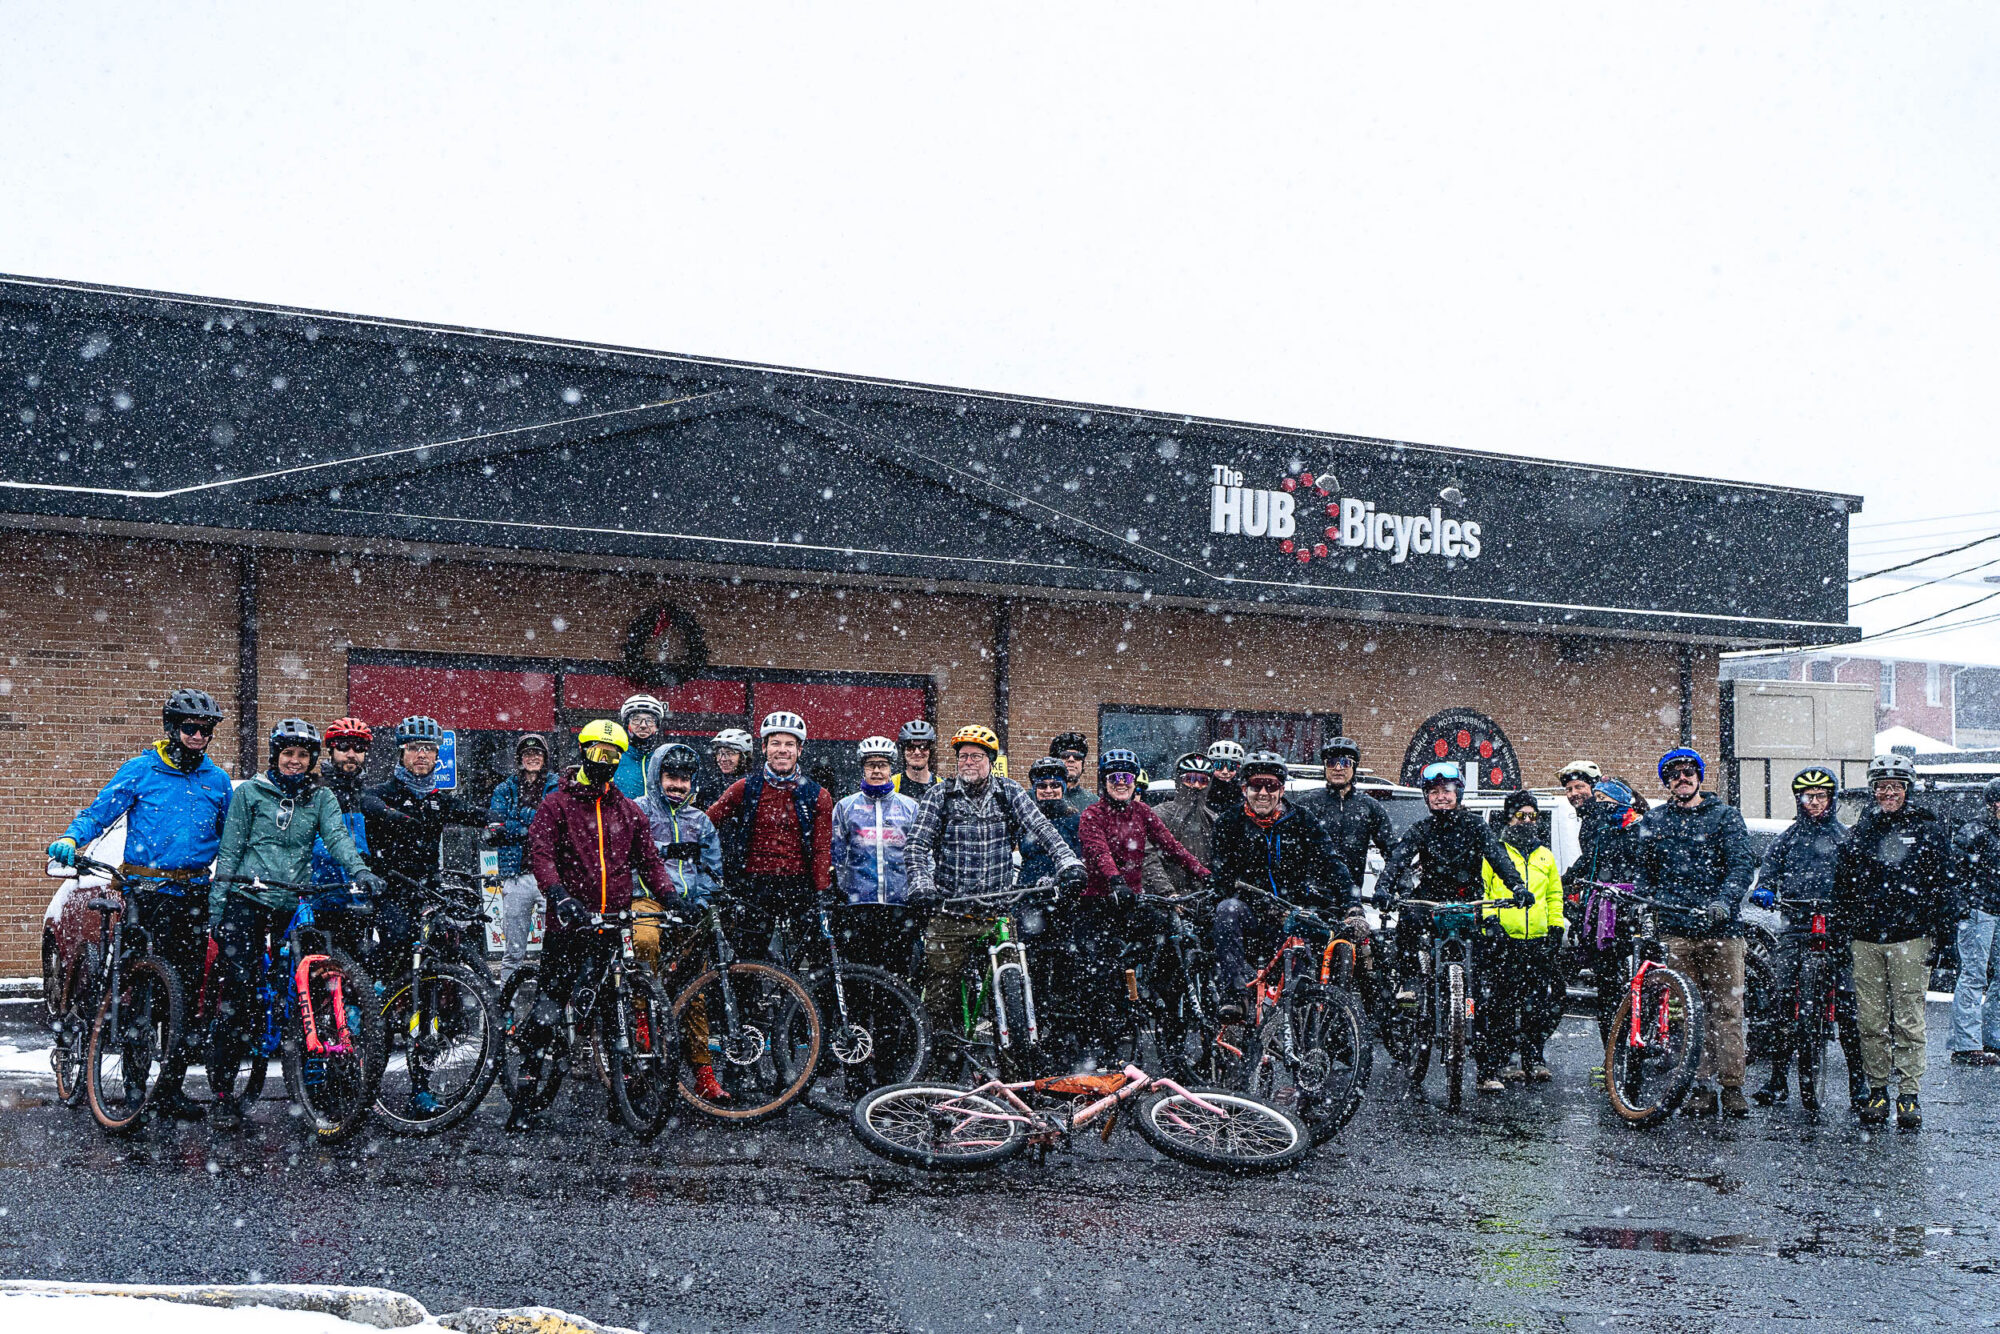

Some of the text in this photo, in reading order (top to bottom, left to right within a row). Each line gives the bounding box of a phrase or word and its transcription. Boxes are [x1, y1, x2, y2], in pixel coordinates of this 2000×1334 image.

[1211, 464, 1244, 487] The
[1210, 485, 1482, 564] HUB Bicycles
